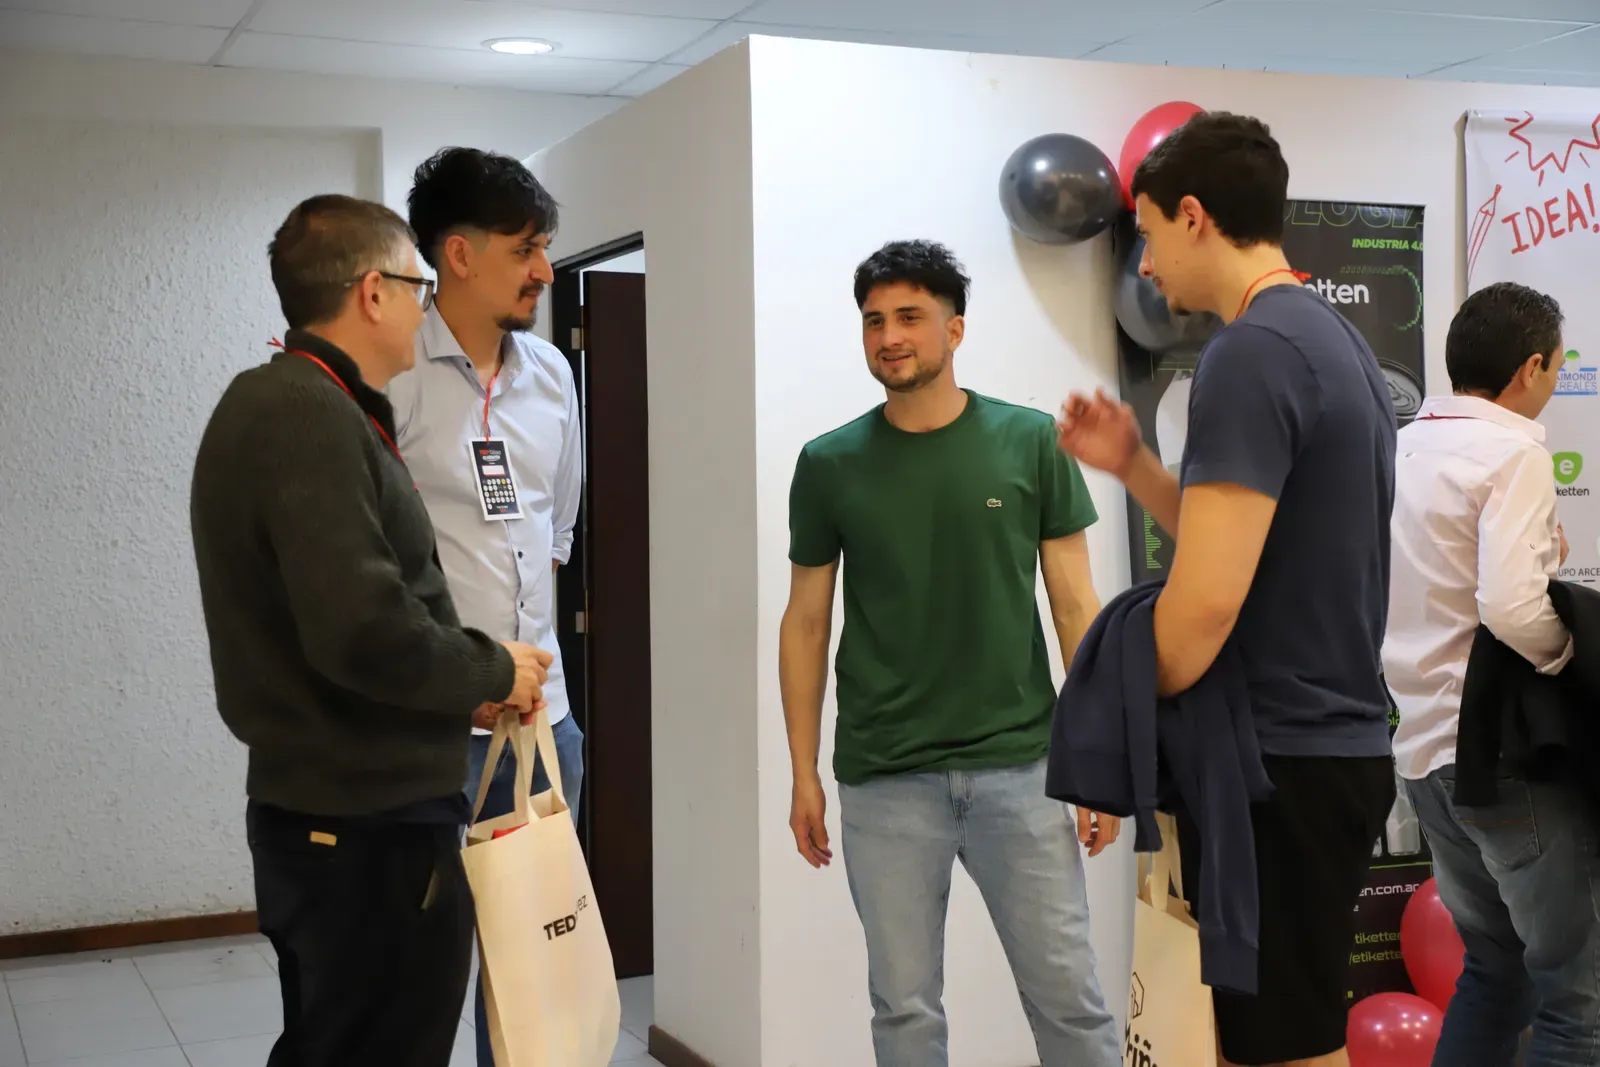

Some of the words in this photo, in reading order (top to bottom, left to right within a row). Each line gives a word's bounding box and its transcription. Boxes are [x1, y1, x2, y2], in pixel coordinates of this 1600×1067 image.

[1501, 182, 1600, 254] IDEA!
[1351, 237, 1409, 250] INDUSTRIA
[1557, 381, 1597, 391] REALES
